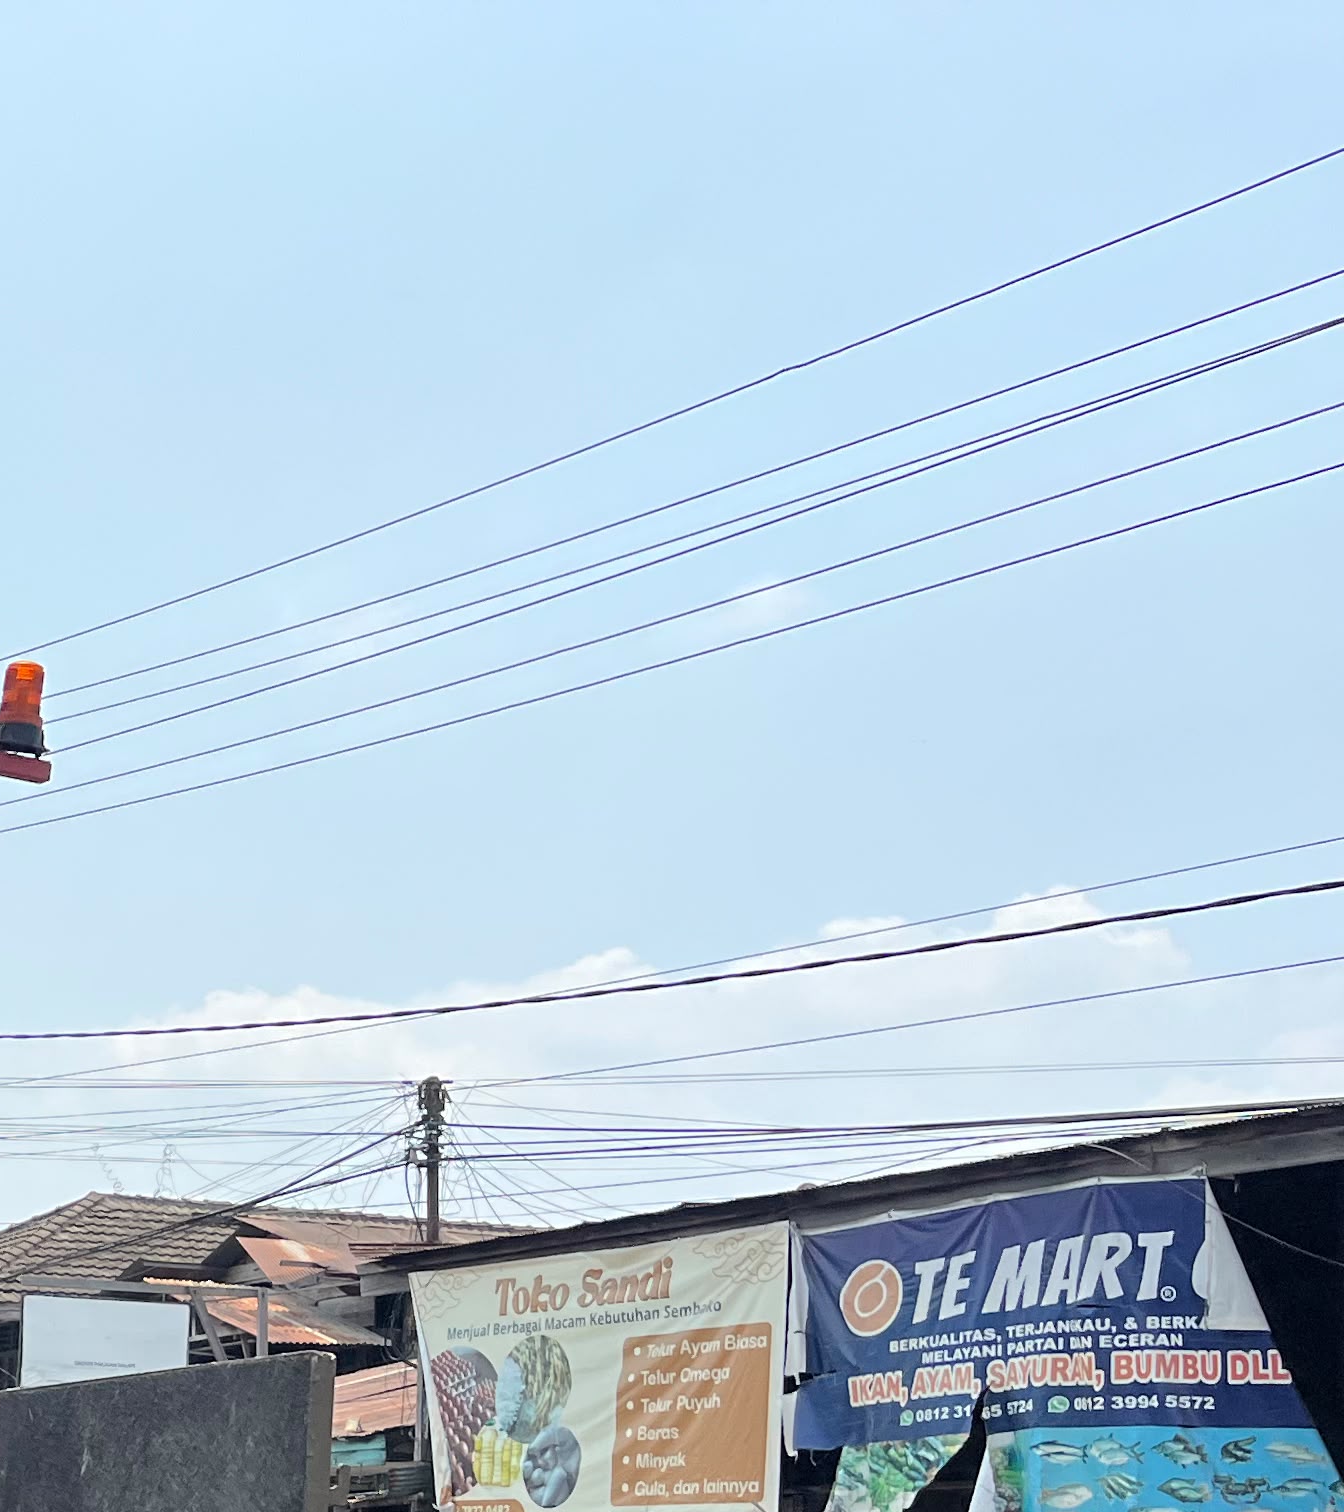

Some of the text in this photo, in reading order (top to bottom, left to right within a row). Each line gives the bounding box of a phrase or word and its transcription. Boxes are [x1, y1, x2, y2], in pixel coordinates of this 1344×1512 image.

[495, 1256, 674, 1317] Toko Sandi
[447, 1325, 491, 1341] Menjual
[493, 1319, 543, 1337] Berbagai
[545, 1315, 586, 1331] Macam
[590, 1308, 660, 1327] Kebutuhan
[889, 1328, 1002, 1353] BERKUALITAS,
[1124, 1316, 1138, 1330] &
[647, 1334, 767, 1358] Telur Ayam Biasa
[921, 1345, 1002, 1364] MELAYANI
[1007, 1337, 1064, 1356] PARTAI
[1099, 1333, 1184, 1349] ECERAN
[640, 1366, 730, 1386] Telur Omega
[848, 1349, 1293, 1408] IKAN, AYAM, SAYURAN, BUMBU DLL
[640, 1393, 721, 1414] Telur Puyuh
[915, 1406, 950, 1422] 0812
[1111, 1394, 1159, 1410] 3994
[1164, 1394, 1216, 1410] 5572
[637, 1425, 680, 1441] Beras
[635, 1451, 686, 1472] Minyak
[634, 1478, 760, 1499] Gula, dan lainnya
